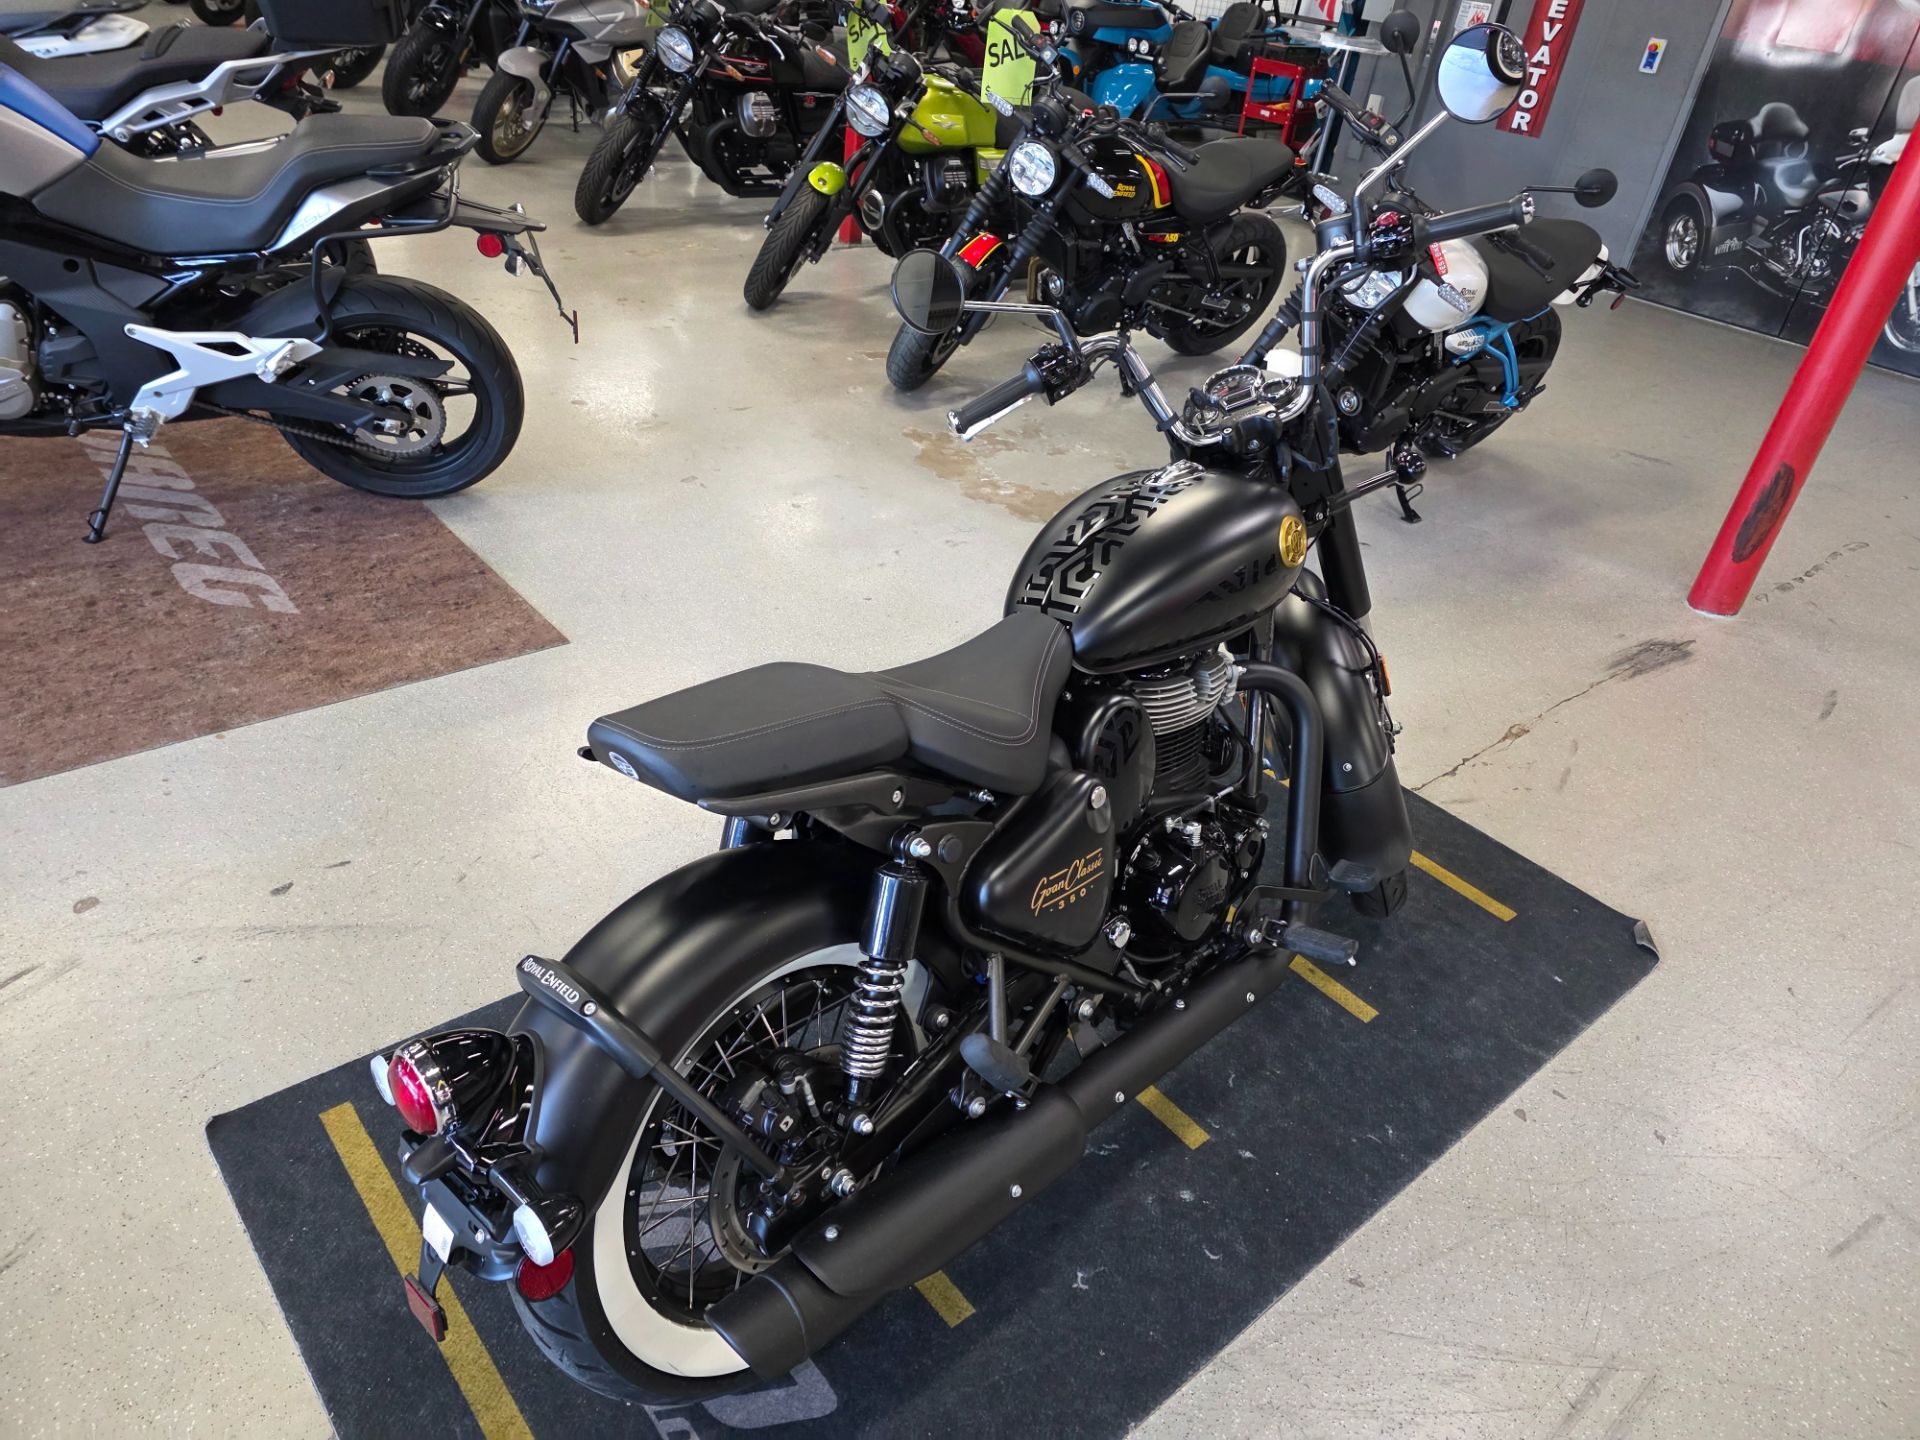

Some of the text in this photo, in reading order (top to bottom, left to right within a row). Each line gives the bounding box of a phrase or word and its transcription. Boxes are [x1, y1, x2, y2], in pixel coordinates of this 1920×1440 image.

[849, 16, 887, 43] SAL
[988, 38, 1026, 68] SAL
[1064, 855, 1104, 891] Classic
[522, 957, 579, 1004] ROYAL ENFIELD
